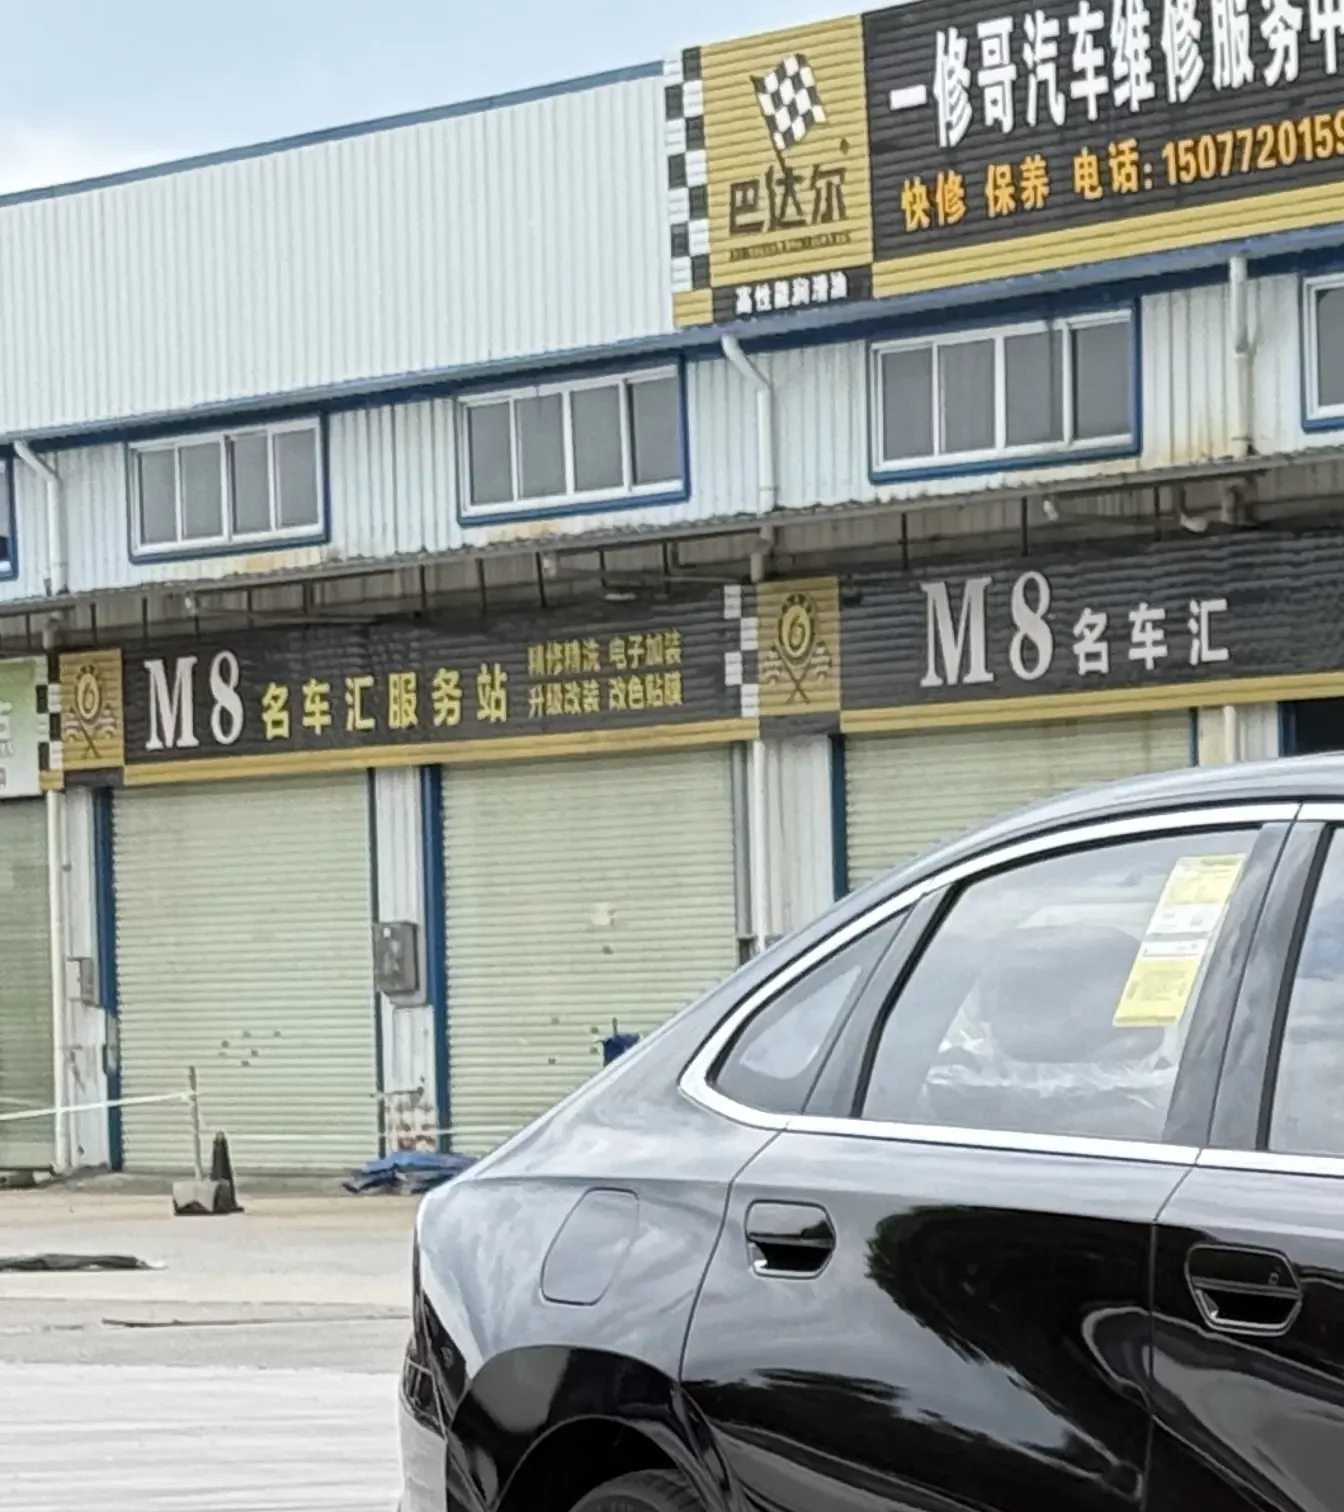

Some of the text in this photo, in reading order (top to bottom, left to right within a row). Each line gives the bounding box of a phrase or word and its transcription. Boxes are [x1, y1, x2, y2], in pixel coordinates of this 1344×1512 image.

[728, 164, 849, 237] 巴达尔
[901, 168, 967, 233] 快修
[985, 154, 1051, 218] 保养
[609, 628, 682, 670] 电子加装
[919, 569, 1230, 689] M8 名车汇
[144, 650, 509, 752] M8 名车汇服务站
[528, 671, 683, 720] 升级改装 改色贴膜
